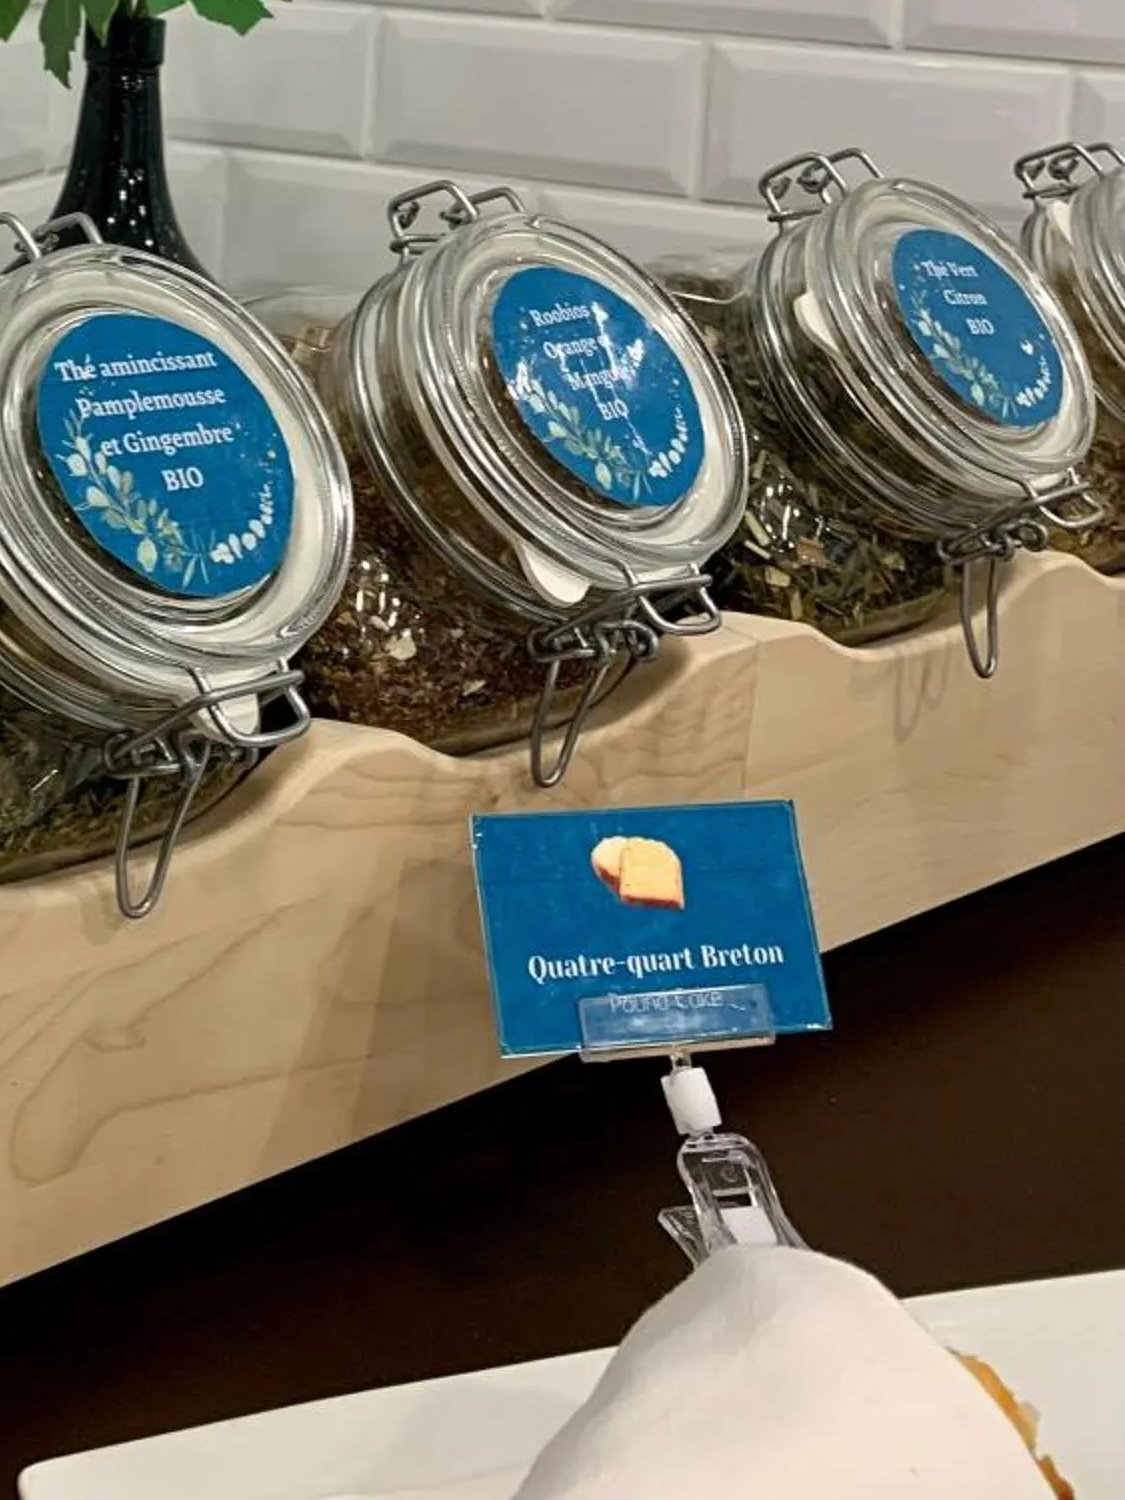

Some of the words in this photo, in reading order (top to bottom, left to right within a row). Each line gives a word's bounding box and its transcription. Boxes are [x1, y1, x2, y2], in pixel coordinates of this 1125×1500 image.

[966, 318, 994, 335] BIO
[543, 337, 599, 360] Orange
[55, 354, 97, 382] Thé
[100, 350, 217, 377] amincissant
[75, 387, 227, 420] Pamplemousse
[597, 398, 628, 421] BIO
[101, 438, 122, 457] et
[125, 423, 235, 456] Gingembre
[162, 466, 204, 491] BIO
[528, 948, 696, 985] Quatre-quart
[700, 944, 785, 968] Breton
